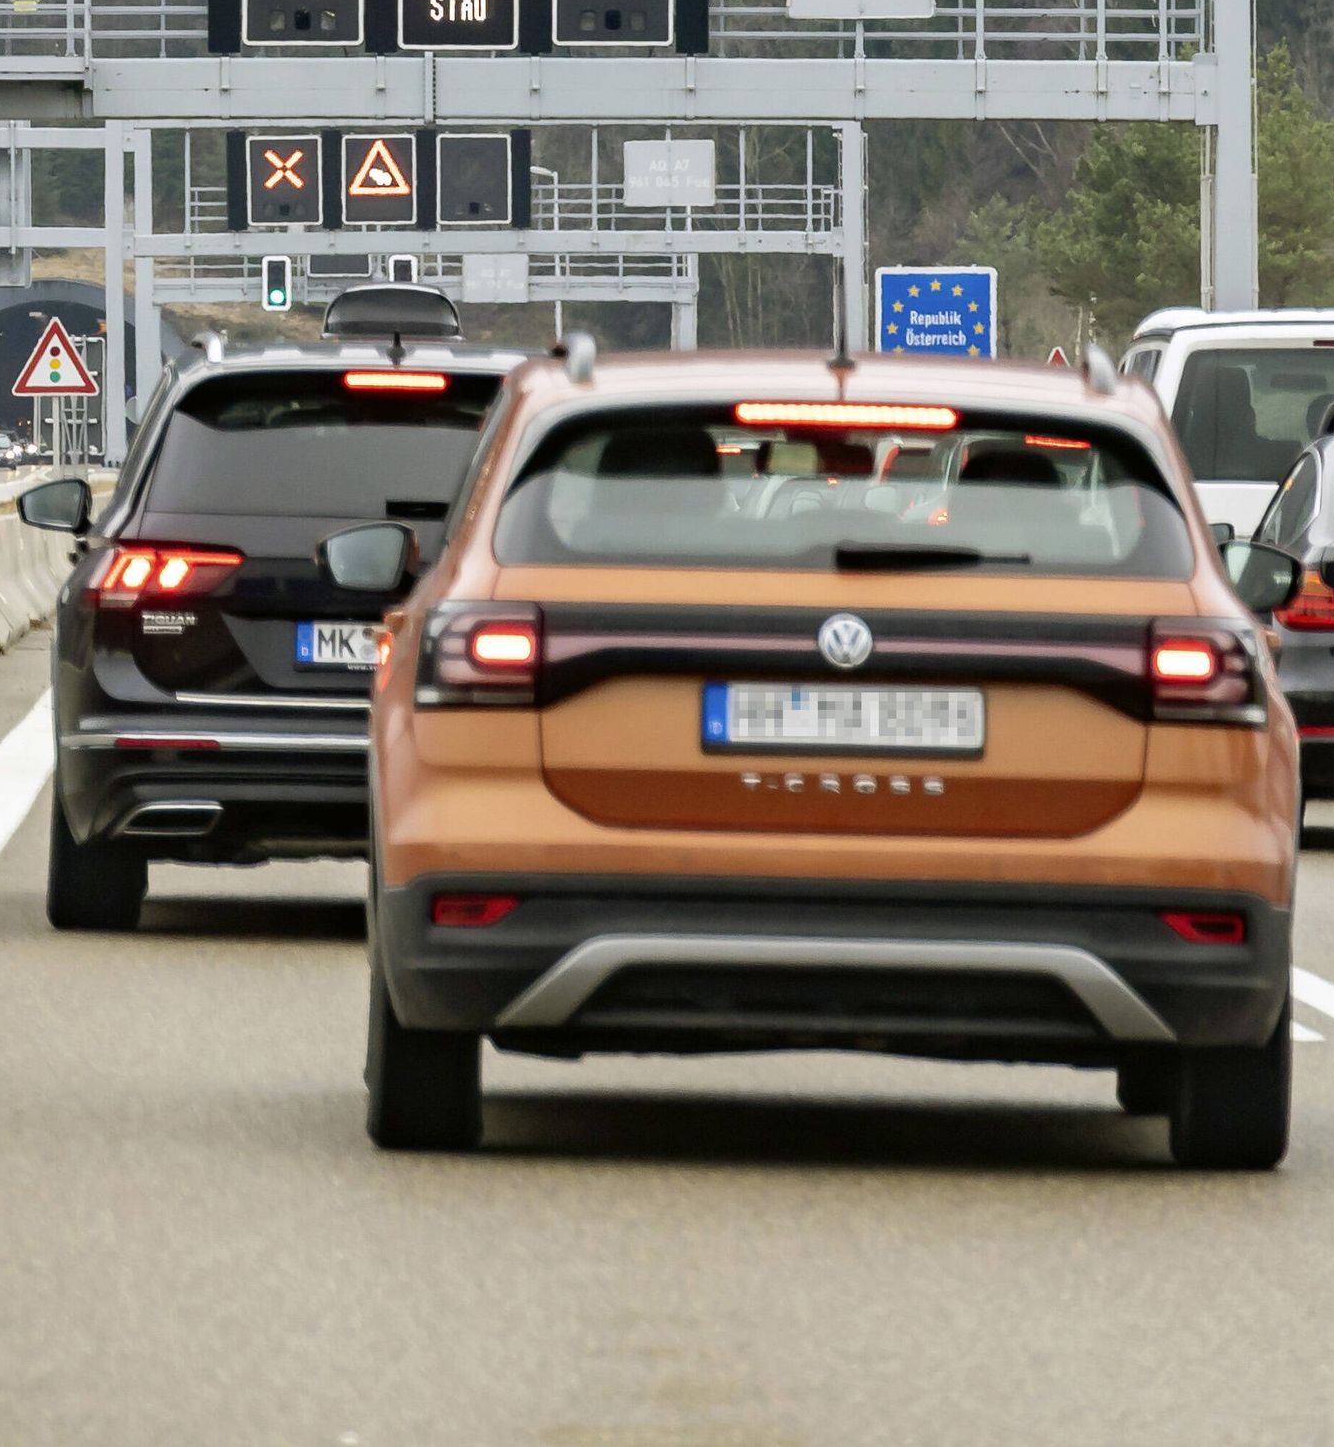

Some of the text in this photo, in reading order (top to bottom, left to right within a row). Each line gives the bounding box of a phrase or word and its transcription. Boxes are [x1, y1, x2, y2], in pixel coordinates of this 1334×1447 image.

[909, 309, 963, 329] Republik
[905, 328, 967, 347] Österreich
[317, 628, 357, 659] MK
